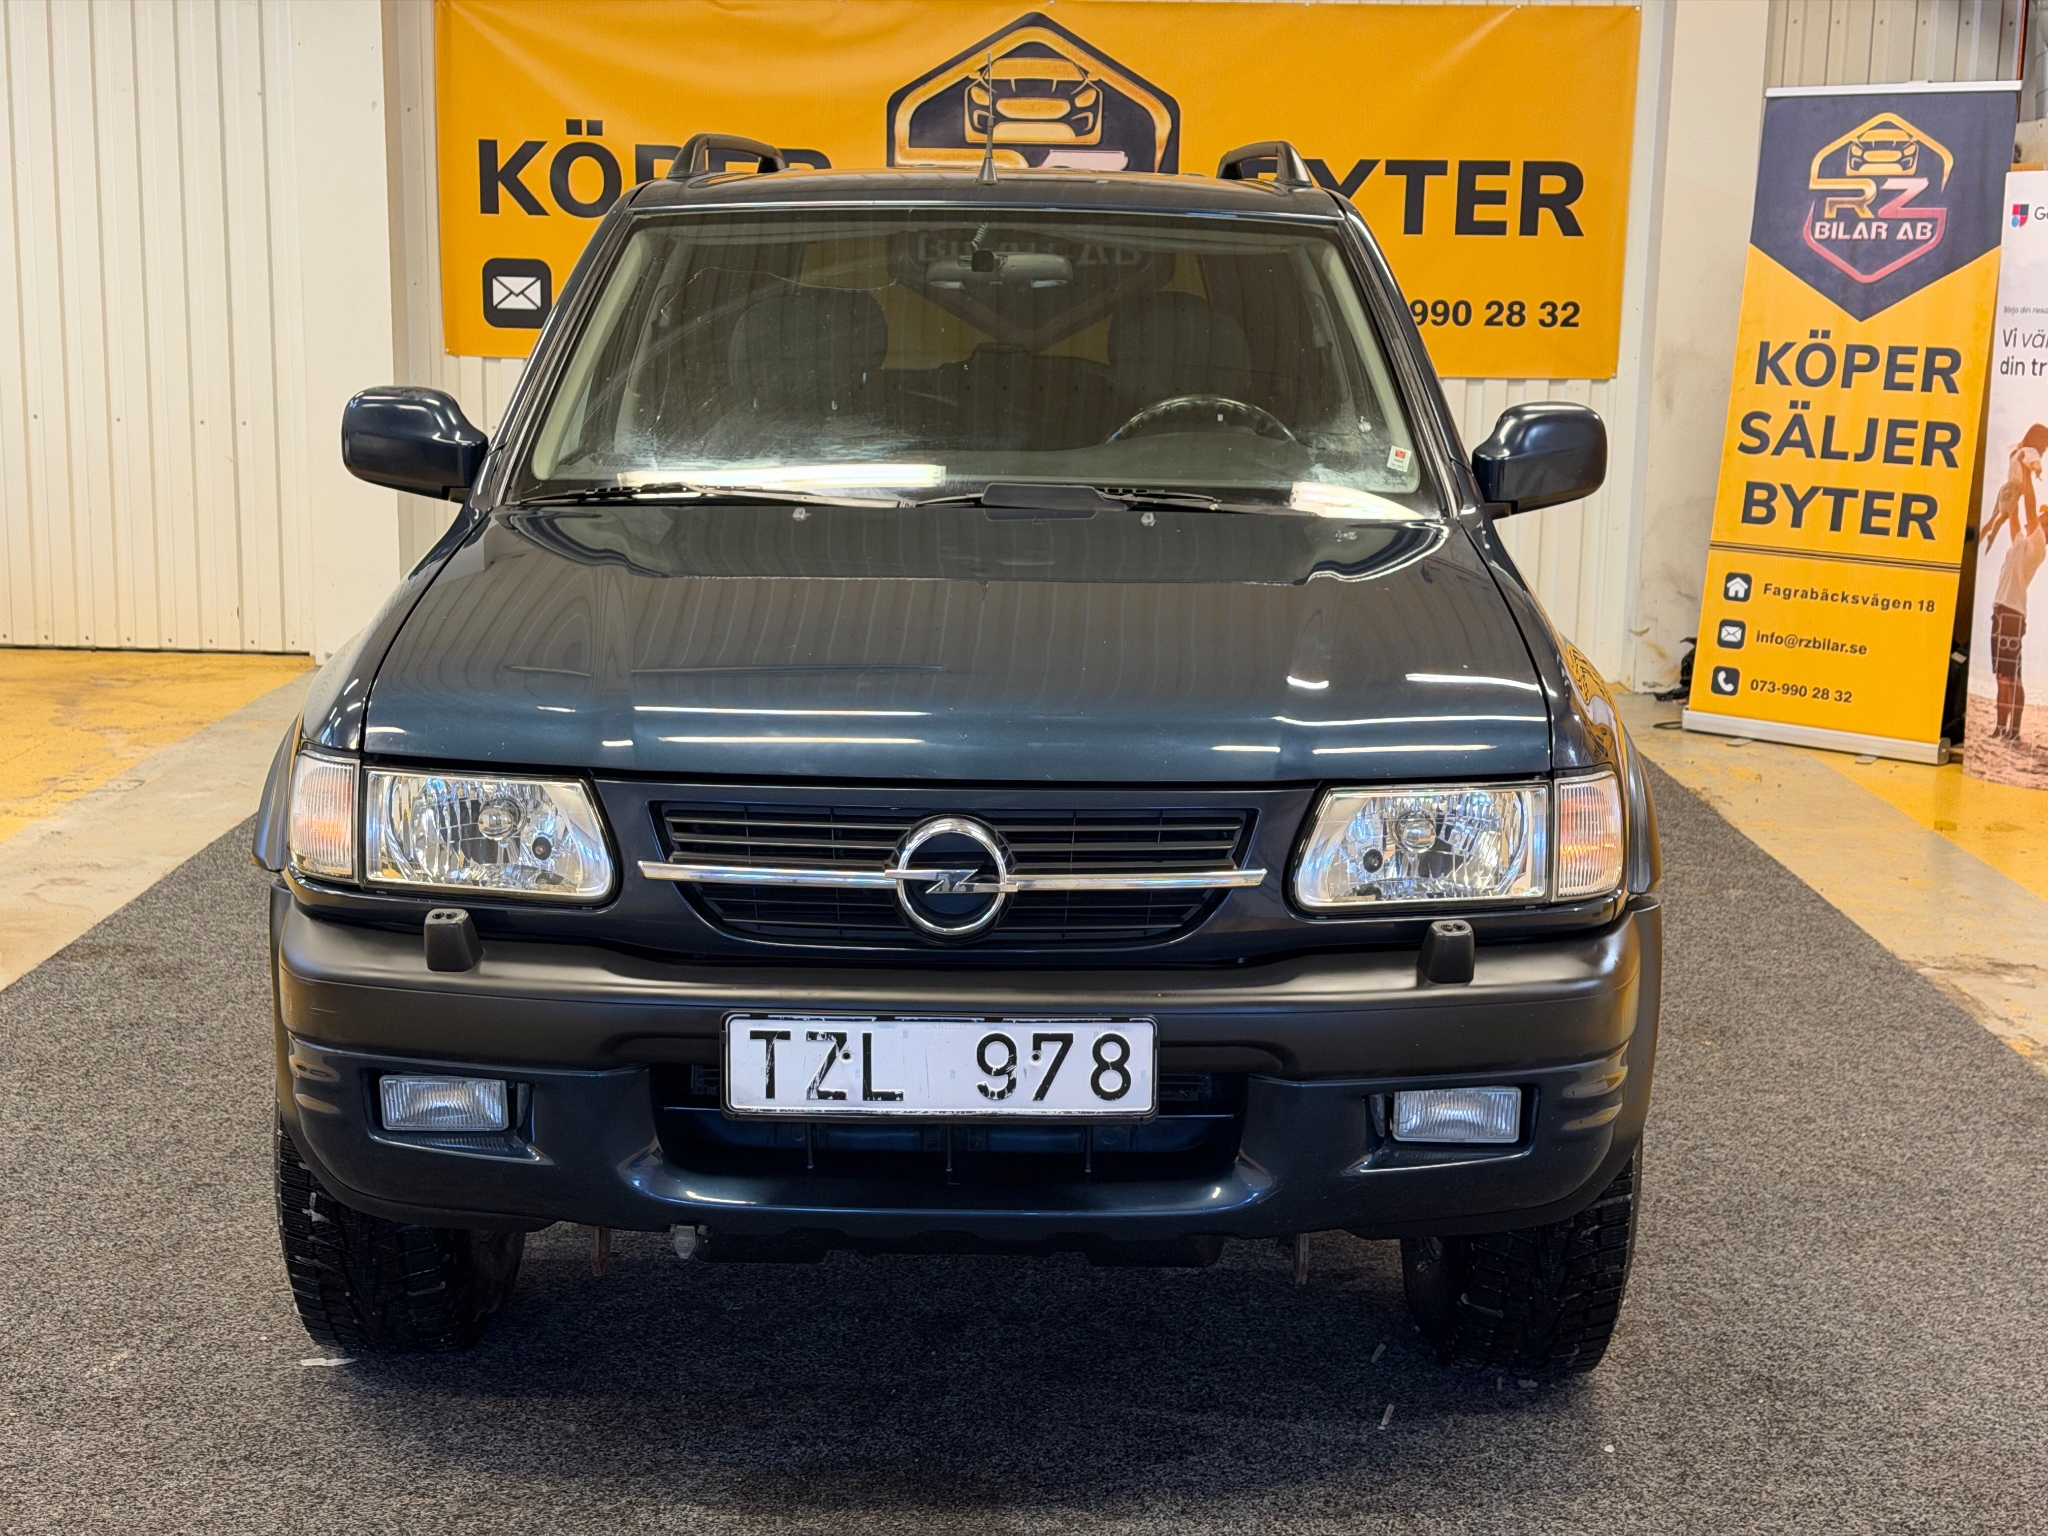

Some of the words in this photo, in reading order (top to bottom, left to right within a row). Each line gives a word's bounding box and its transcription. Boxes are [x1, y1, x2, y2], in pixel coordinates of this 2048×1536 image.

[1242, 158, 1585, 237] YTER
[1814, 221, 1888, 241] BILAR
[1896, 221, 1934, 241] AB
[1484, 300, 1526, 328] 28
[1538, 300, 1581, 329] 32
[2002, 326, 2017, 348] Vi
[1755, 329, 1962, 394] KÖPER
[2000, 354, 2026, 376] din
[1737, 400, 1962, 468] SÄLJER
[1741, 481, 1938, 540] BYTER
[1763, 583, 1913, 611] Fagrabäcksvägen
[1918, 599, 1936, 613] 18
[1750, 678, 1808, 698] 073-990
[1811, 686, 1831, 701] 28
[1834, 689, 1853, 704] 32
[749, 1030, 904, 1101] TZL
[976, 1032, 1132, 1102] 978
